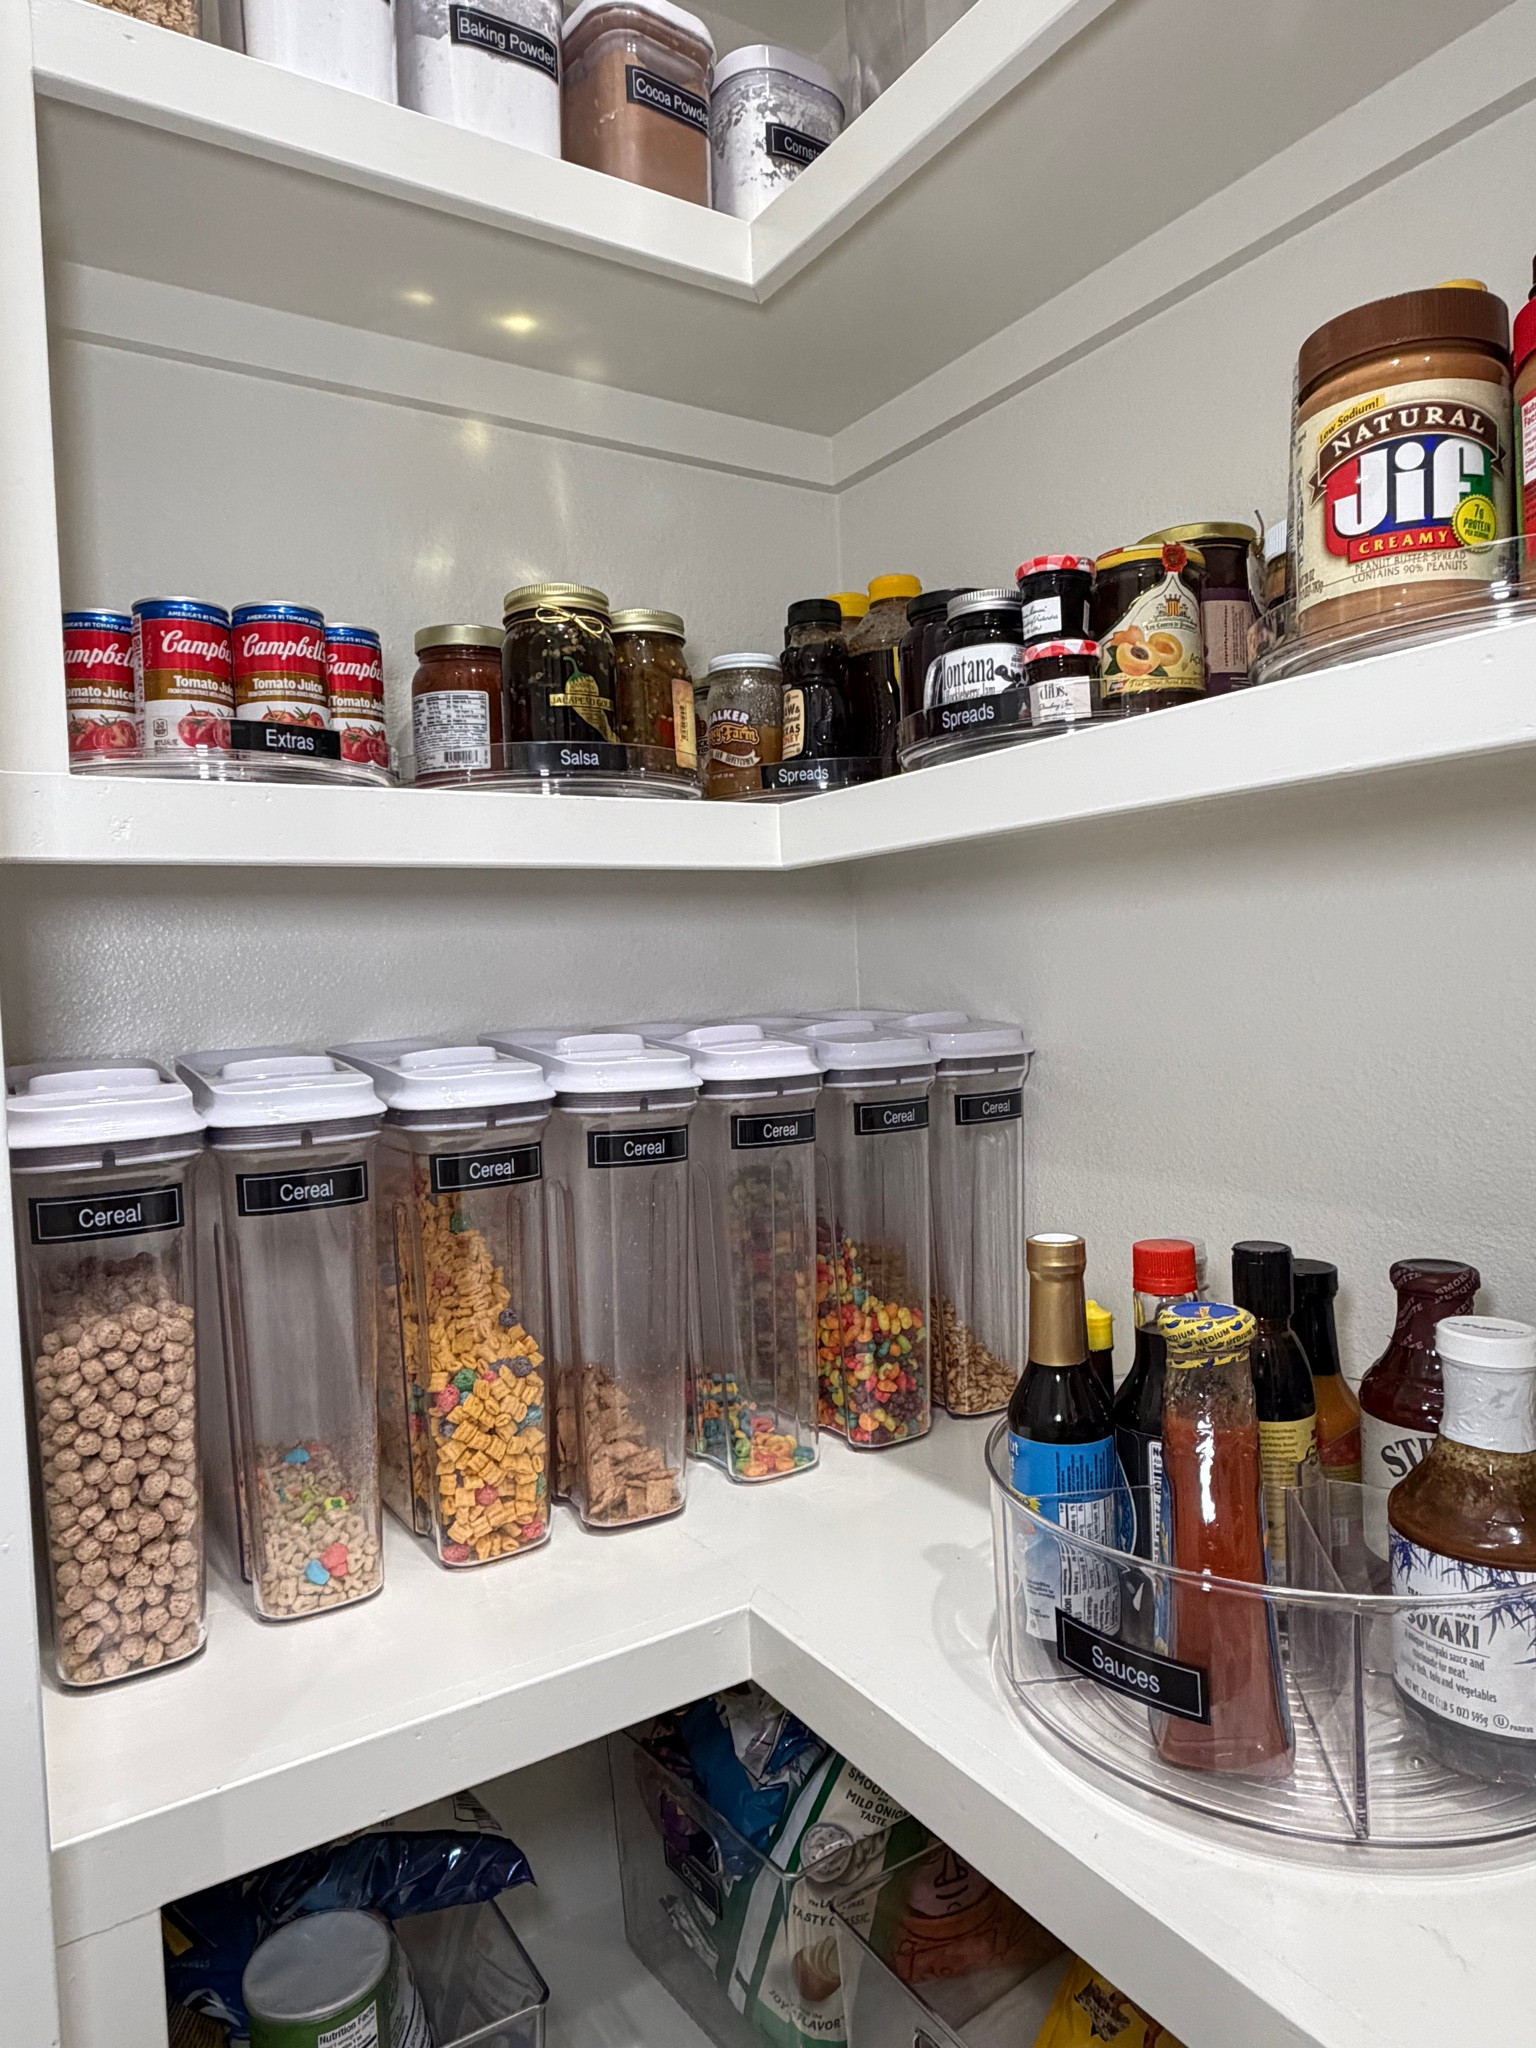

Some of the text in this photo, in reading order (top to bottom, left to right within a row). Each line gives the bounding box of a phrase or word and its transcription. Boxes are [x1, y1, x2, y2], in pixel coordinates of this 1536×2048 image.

[460, 18, 556, 68] Baking Powder
[635, 77, 709, 127] Cocoa Powde
[1320, 397, 1380, 442] Low Sodium!
[1331, 407, 1485, 456] NATURAL
[1334, 438, 1485, 536] Jif
[1473, 503, 1485, 518] 7g
[1463, 518, 1491, 534] PROTEIN
[1359, 530, 1448, 554] CREAMY
[1352, 561, 1468, 583] CONTAINS 90% PEANUTS
[1355, 550, 1466, 573] PEANUT BUTTER SPREAD
[103, 686, 135, 701] Juice
[174, 675, 219, 691] Tomato
[252, 677, 323, 694] Tomato Juice
[331, 695, 371, 709] Tomato
[711, 709, 750, 724] ALKER
[942, 703, 995, 731] Spreads
[266, 728, 314, 751] Extras
[561, 749, 600, 766] Salsa
[778, 765, 829, 786] Spreads
[883, 1107, 916, 1125] Cereal
[982, 1099, 1011, 1115] Cereal
[763, 1121, 799, 1138] Cereal
[624, 1139, 666, 1157] Cereal
[469, 1158, 516, 1179] Cereal
[279, 1178, 335, 1202] Cereal
[78, 1202, 143, 1229] Cereal
[1196, 1328, 1231, 1346] MEDIUM
[1408, 1612, 1480, 1650] SOYAKI
[1091, 1644, 1161, 1694] Sauces
[1449, 1652, 1468, 1666] sauce
[1470, 1657, 1485, 1671] and
[1455, 1682, 1498, 1703] vegetables
[1471, 1710, 1489, 1727] 595g
[846, 1788, 874, 1810] MILD
[860, 1811, 888, 1827] TASTE
[792, 1904, 826, 1927] TASTY
[320, 2021, 357, 2045] Nutrition
